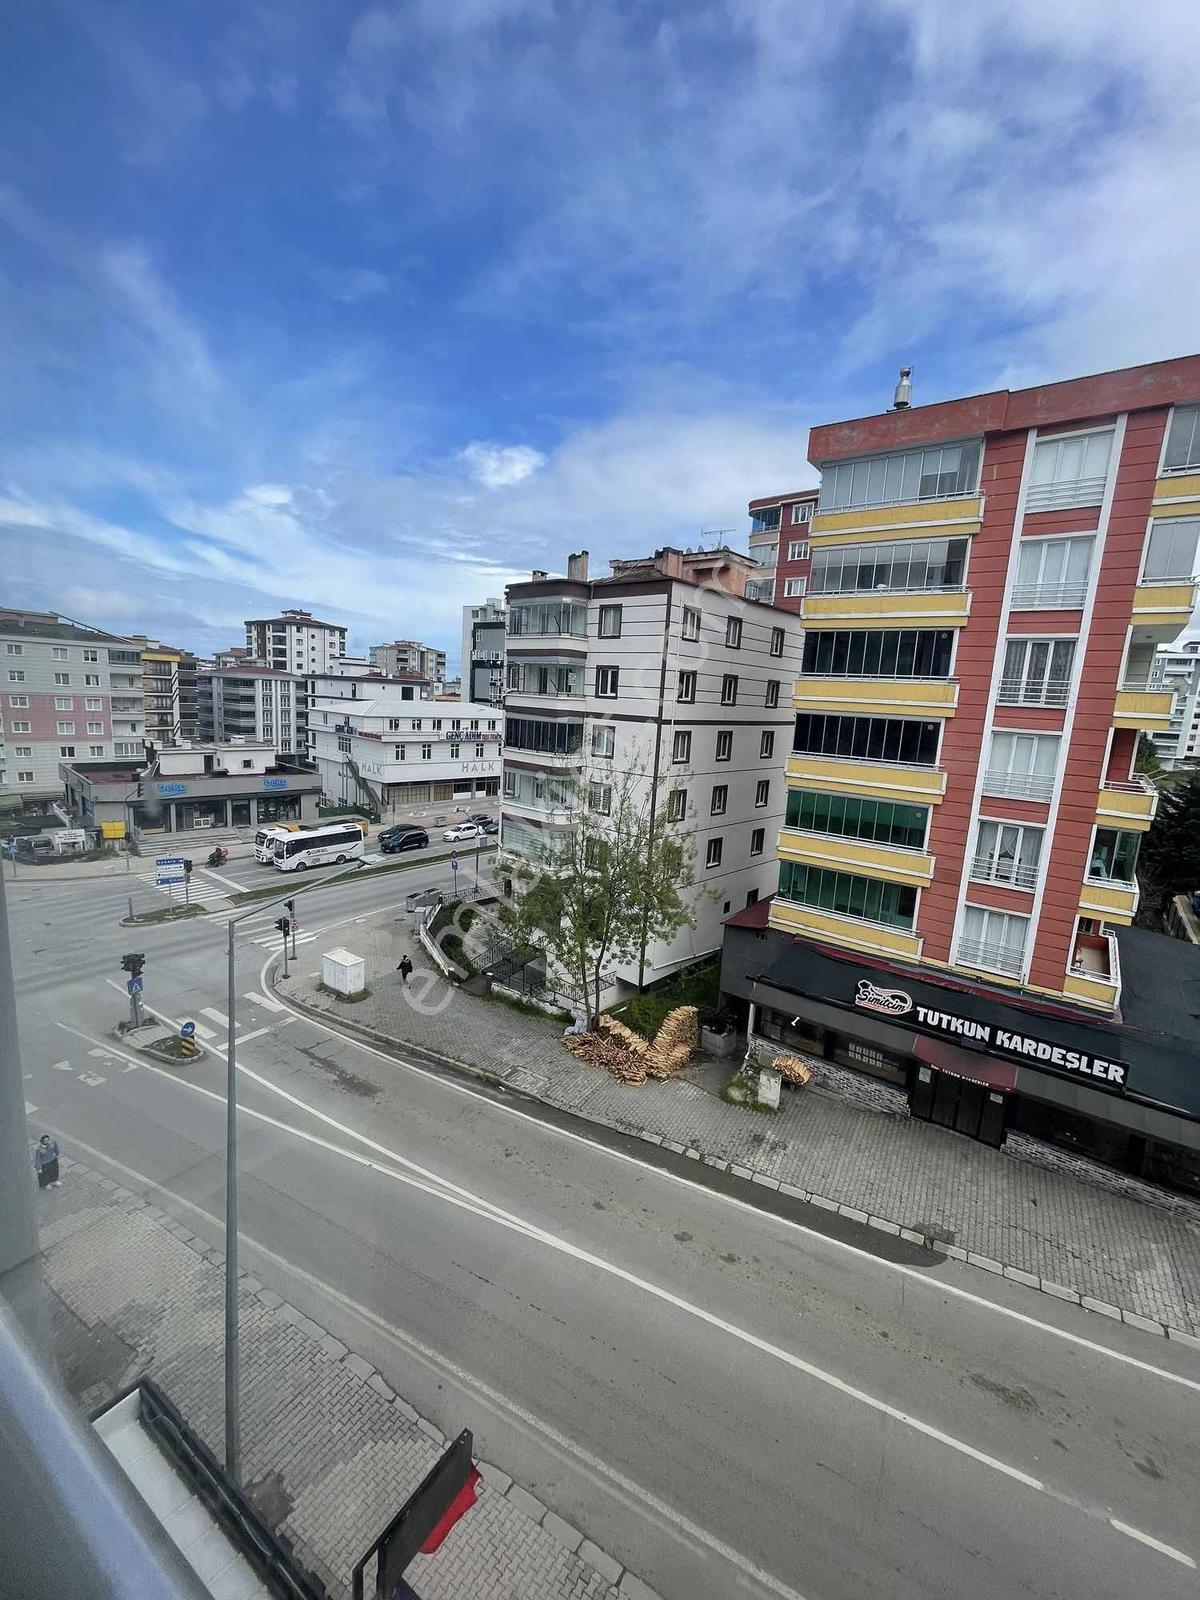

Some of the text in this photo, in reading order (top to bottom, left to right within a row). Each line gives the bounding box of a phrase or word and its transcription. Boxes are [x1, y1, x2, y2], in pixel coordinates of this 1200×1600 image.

[361, 762, 383, 776] HALK
[461, 762, 495, 773] HALK
[916, 1006, 1126, 1084] TUTKUN KARDEŞLER
